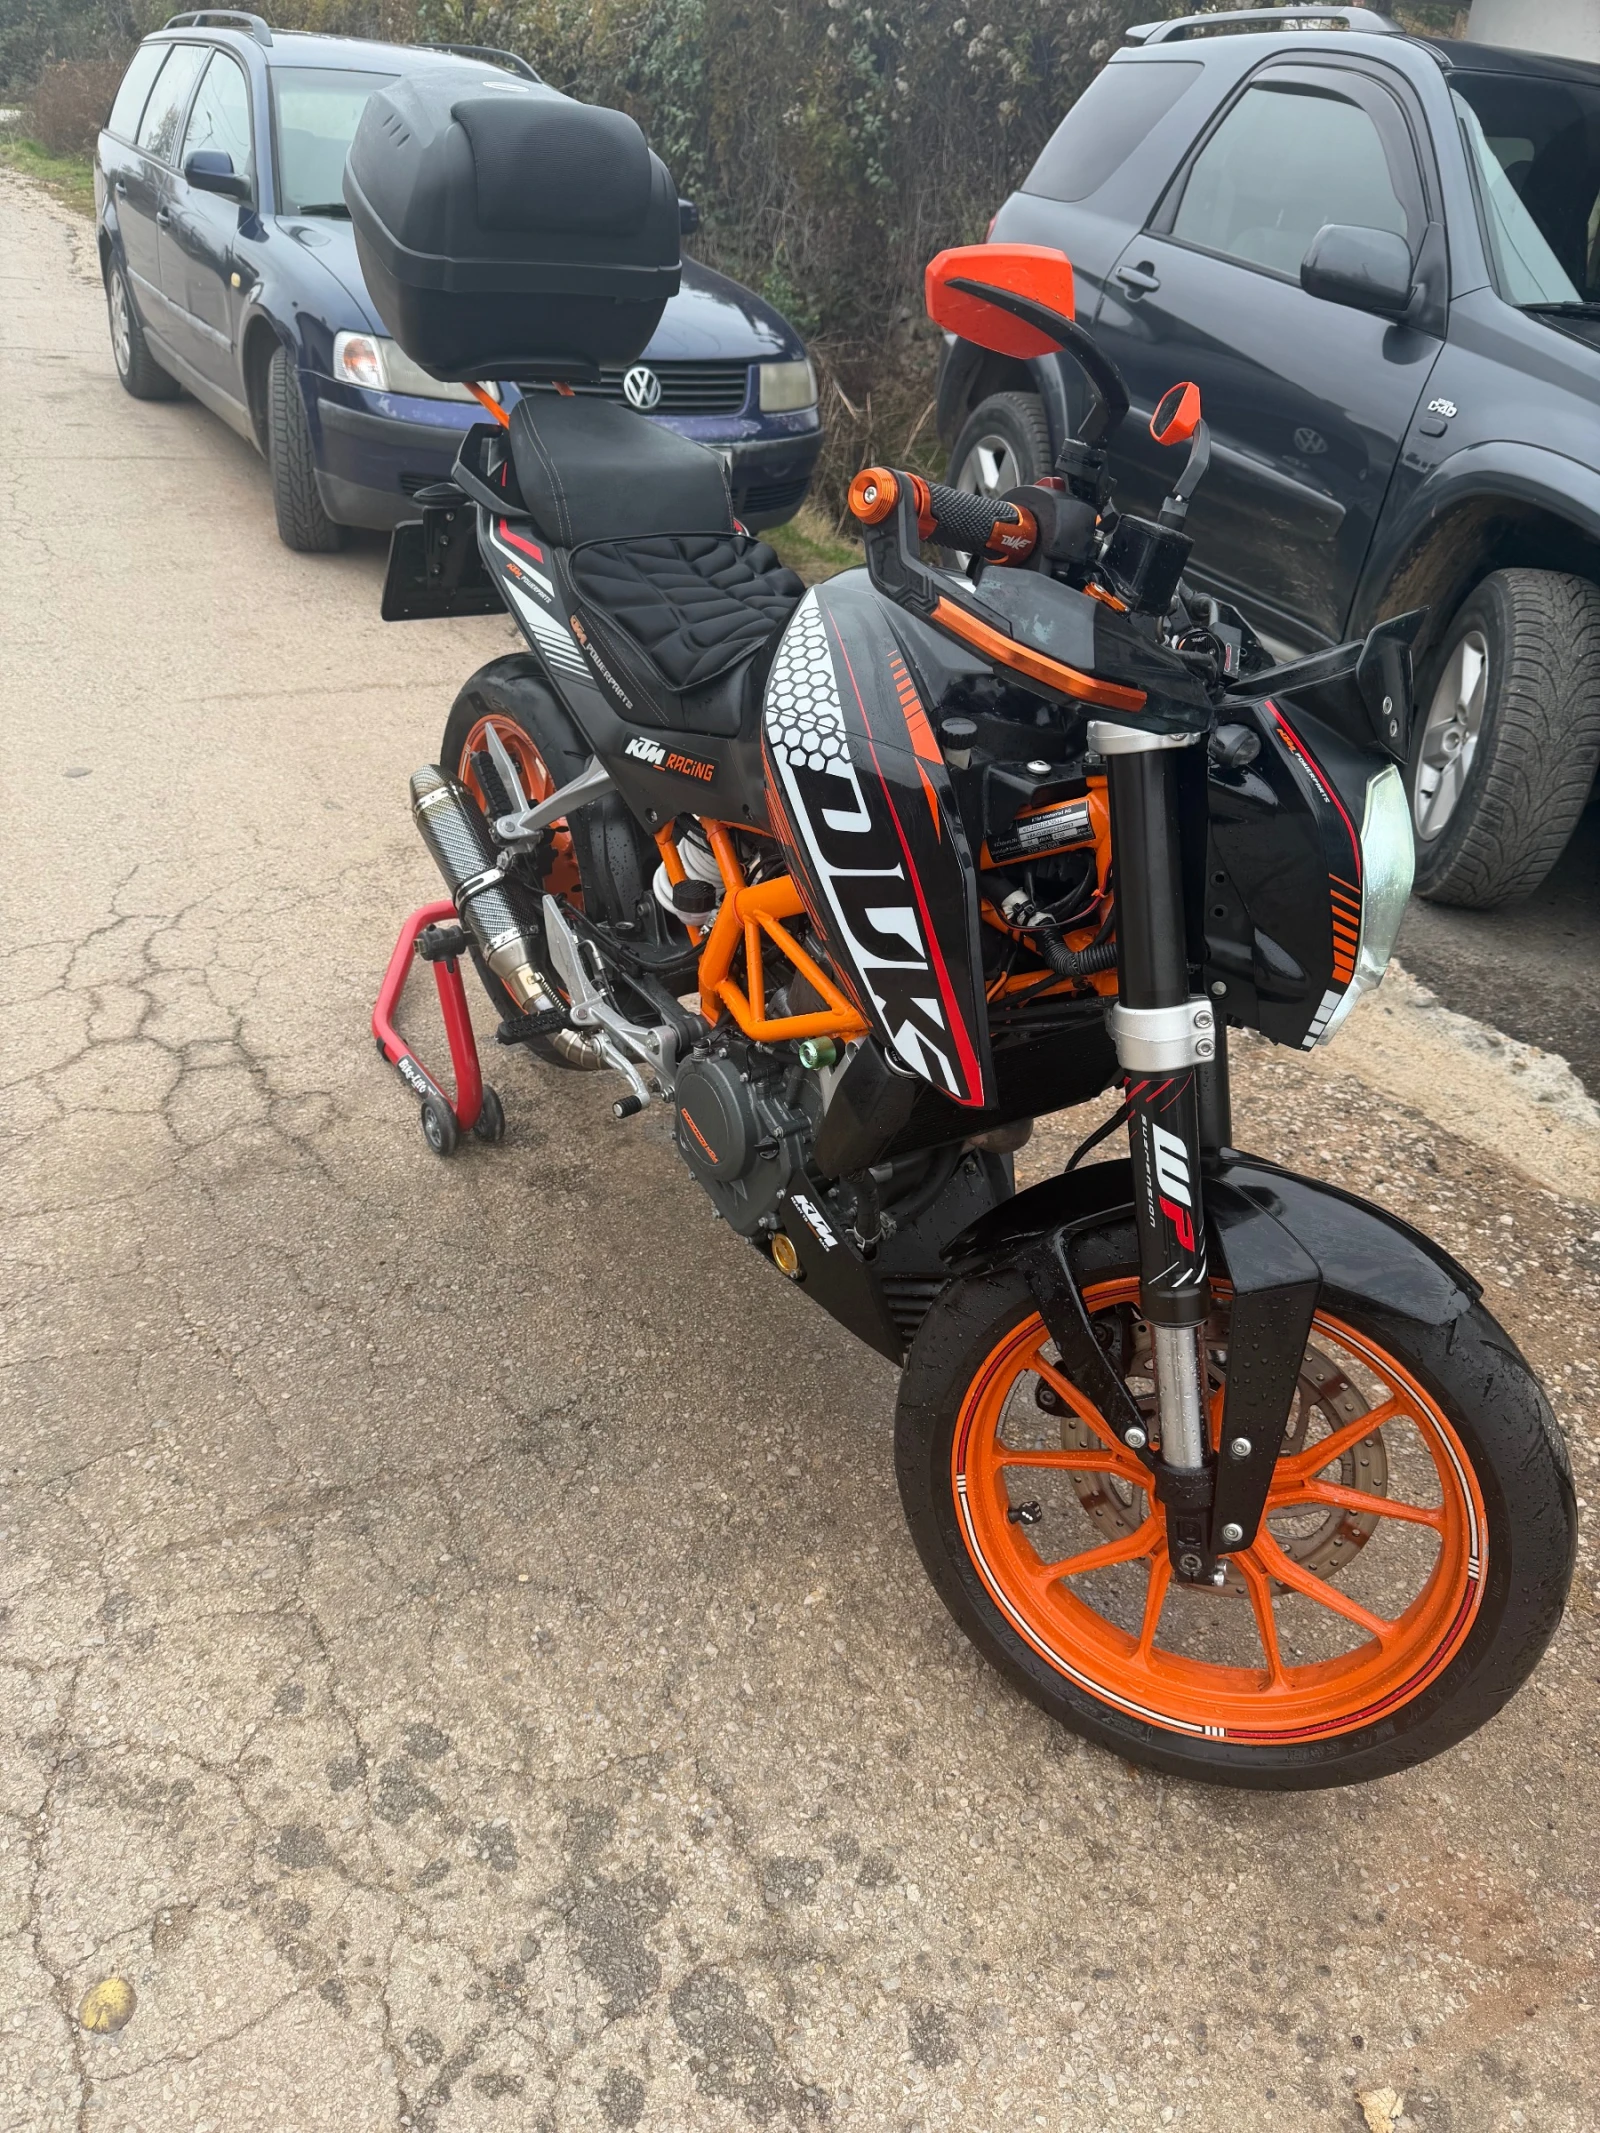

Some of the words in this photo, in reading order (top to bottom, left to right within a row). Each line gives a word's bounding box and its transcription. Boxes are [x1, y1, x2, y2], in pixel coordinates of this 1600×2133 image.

[1001, 534, 1032, 550] DUKE
[586, 643, 634, 709] POWERPARTS
[624, 736, 667, 766] KTM
[1295, 753, 1331, 803] POWERPARTS
[1152, 1123, 1196, 1252] WP
[793, 1194, 839, 1247] KTM
